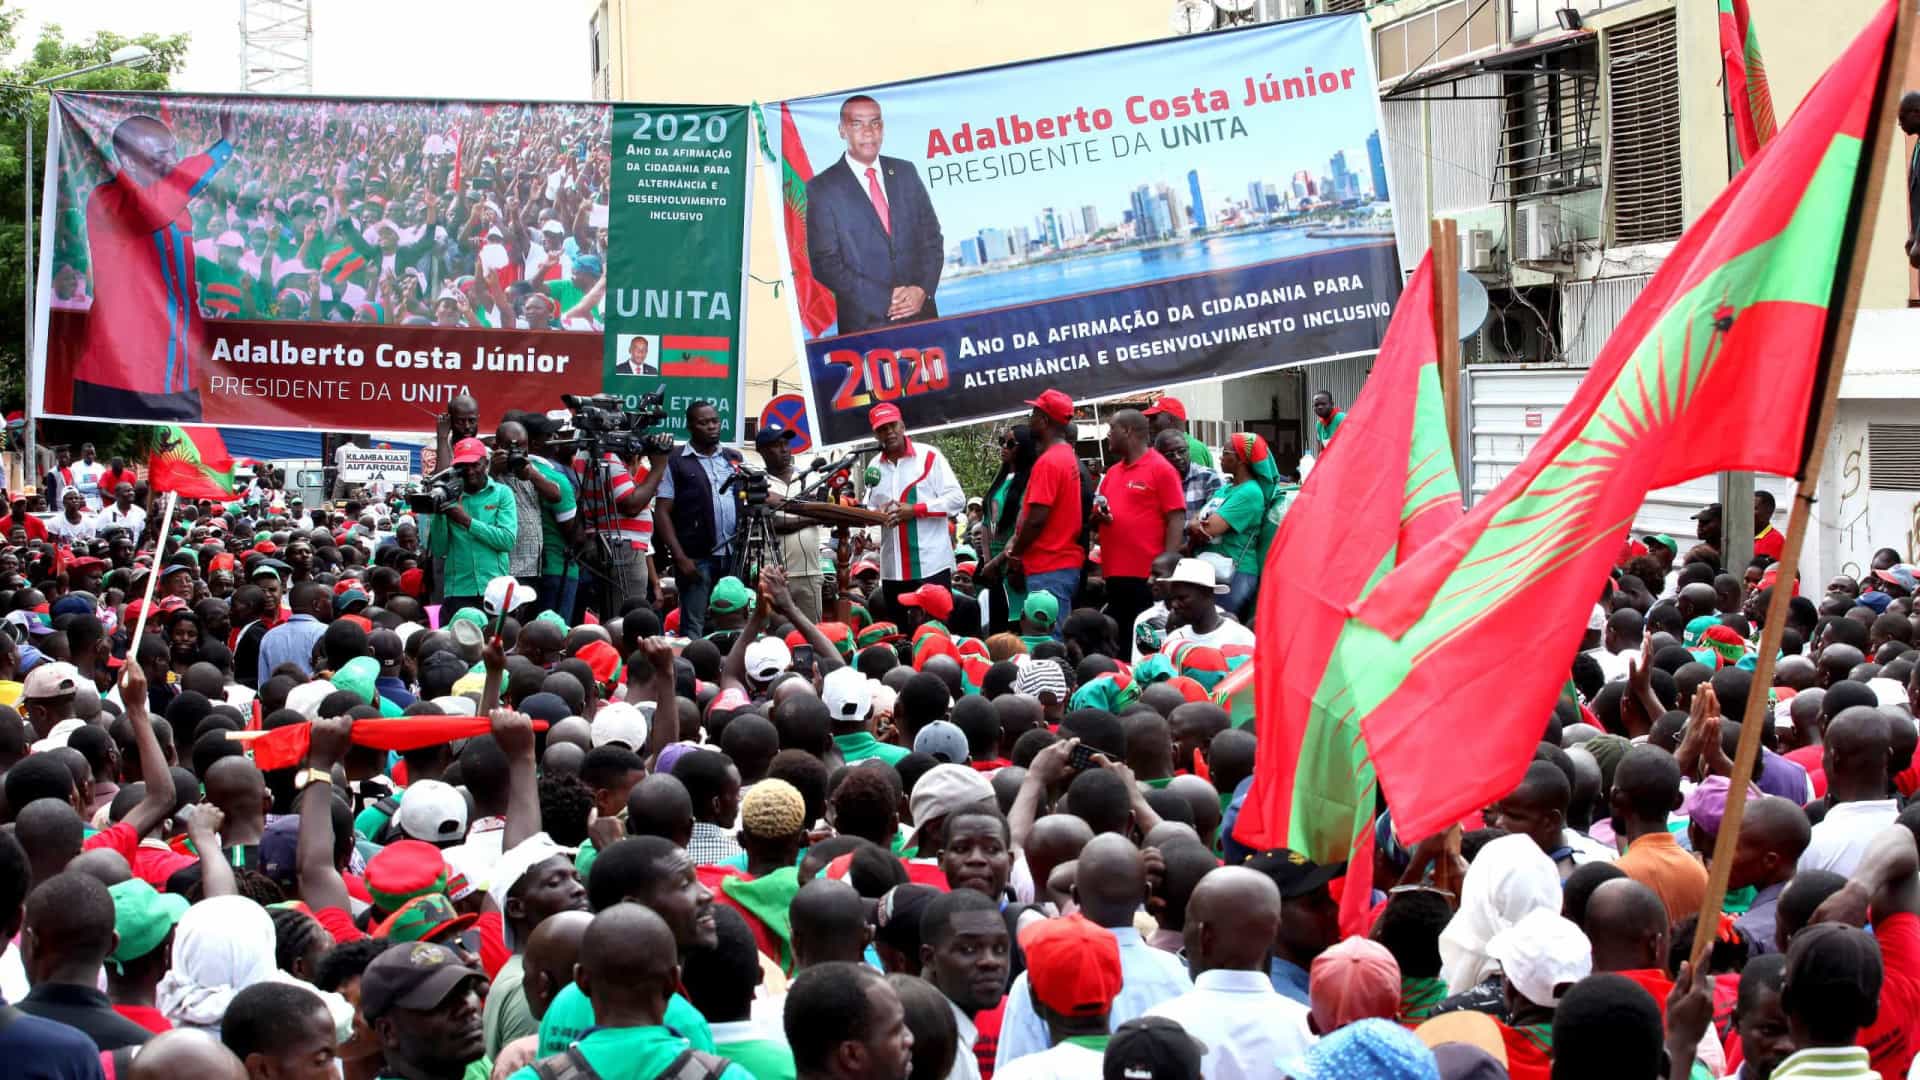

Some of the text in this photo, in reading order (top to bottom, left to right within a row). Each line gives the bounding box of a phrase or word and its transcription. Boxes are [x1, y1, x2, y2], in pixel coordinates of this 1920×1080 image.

[926, 67, 1356, 159] Adalberto Costa Júnior
[632, 112, 728, 143] 2020
[655, 148, 669, 157] DA
[673, 147, 732, 160] AFIRMAÇÃO
[928, 117, 1248, 189] PRESIDENTE DA UNITA
[626, 162, 730, 175] DA CIDADANIA PARA
[638, 178, 718, 190] ALTERNÂNCIA E
[627, 194, 727, 206] DESENVOLVIMENTO
[650, 211, 703, 221] INCLUSIVO
[616, 288, 732, 321] UNITA
[1013, 331, 1039, 347] DA
[1048, 309, 1159, 343] AFIRMAÇÃO
[1167, 306, 1194, 323] DA
[1201, 284, 1307, 316] CIDADANIA
[1313, 274, 1364, 296] PARA
[211, 338, 570, 373] Adalberto Costa Júnior
[964, 301, 1391, 389] ALTERNÂNCIA E DESENVOLVIMENTO INCLUSIVO
[210, 376, 351, 400] PRESIDENTE
[360, 382, 391, 401] DA
[824, 346, 950, 411] 2020
[347, 463, 408, 471] AUTARQUIAS
[367, 471, 385, 480] JÁ
